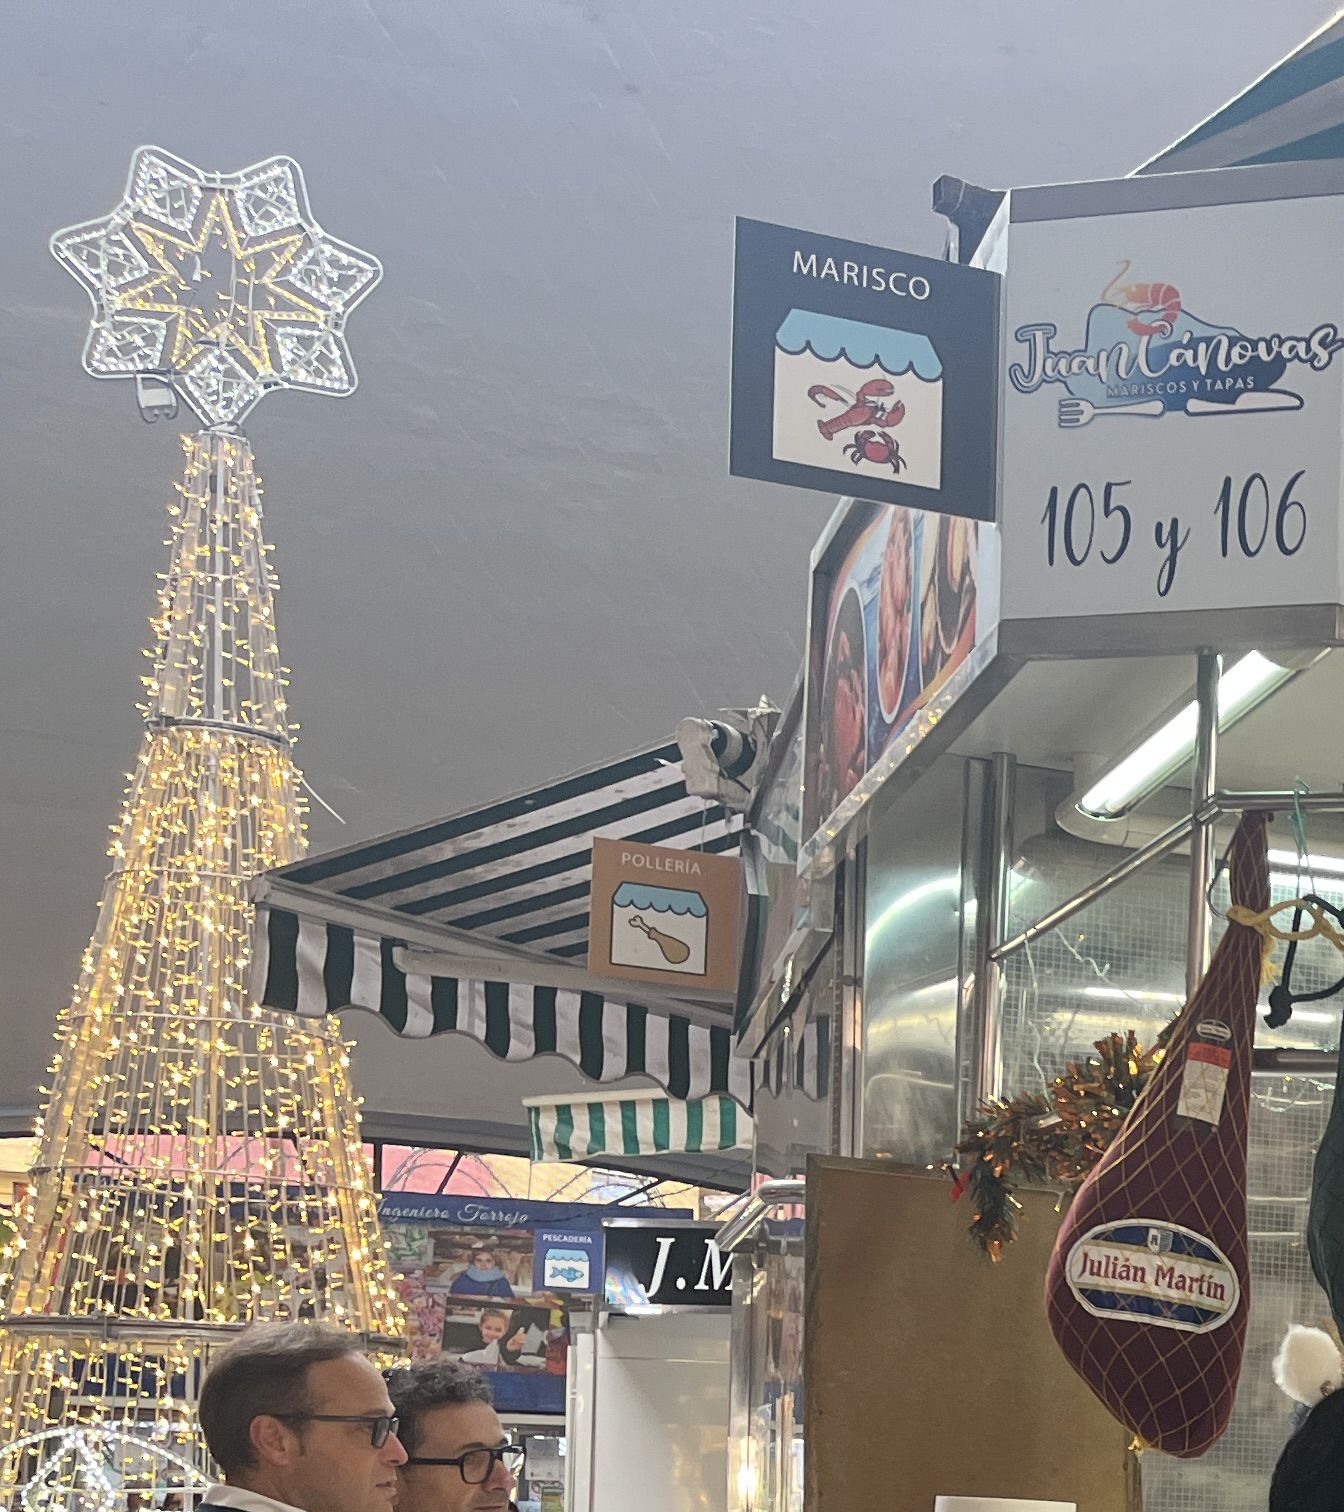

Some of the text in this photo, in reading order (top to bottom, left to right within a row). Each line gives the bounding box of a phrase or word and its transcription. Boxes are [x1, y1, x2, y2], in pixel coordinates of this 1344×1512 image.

[793, 250, 931, 300] MARISCO
[1010, 322, 1130, 393] Juan
[1106, 376, 1255, 398] MARISCOS Y TAPAS
[1041, 469, 1307, 597] 105 y 106
[621, 852, 702, 876] POLLERÍA
[1080, 1252, 1227, 1302] Julián Martín
